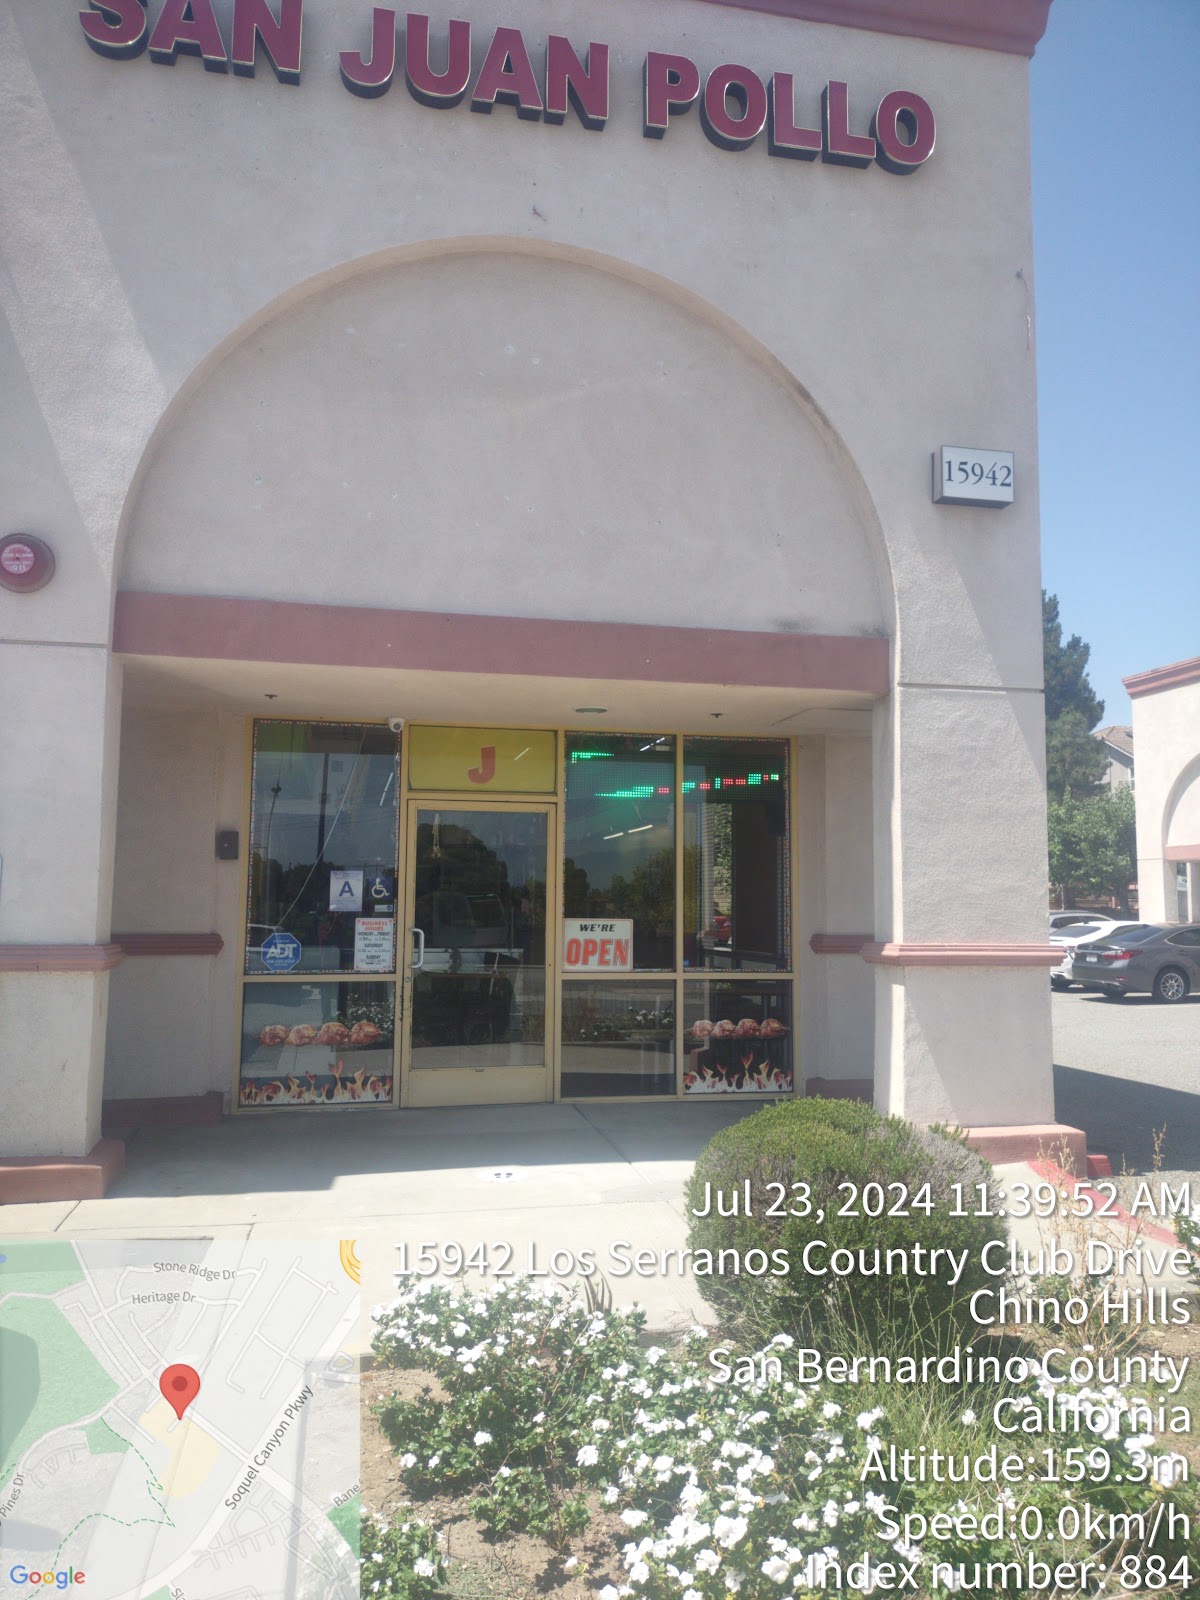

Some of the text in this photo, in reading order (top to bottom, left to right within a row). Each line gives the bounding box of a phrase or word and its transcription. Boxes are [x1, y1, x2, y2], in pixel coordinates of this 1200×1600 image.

[79, 0, 937, 176] SAN JUAN POLLO
[944, 460, 1012, 487] 15942
[467, 746, 496, 784] J
[339, 880, 354, 896] A
[579, 924, 616, 932] WE'RE
[265, 943, 298, 959] ADT
[565, 938, 629, 966] OPEN
